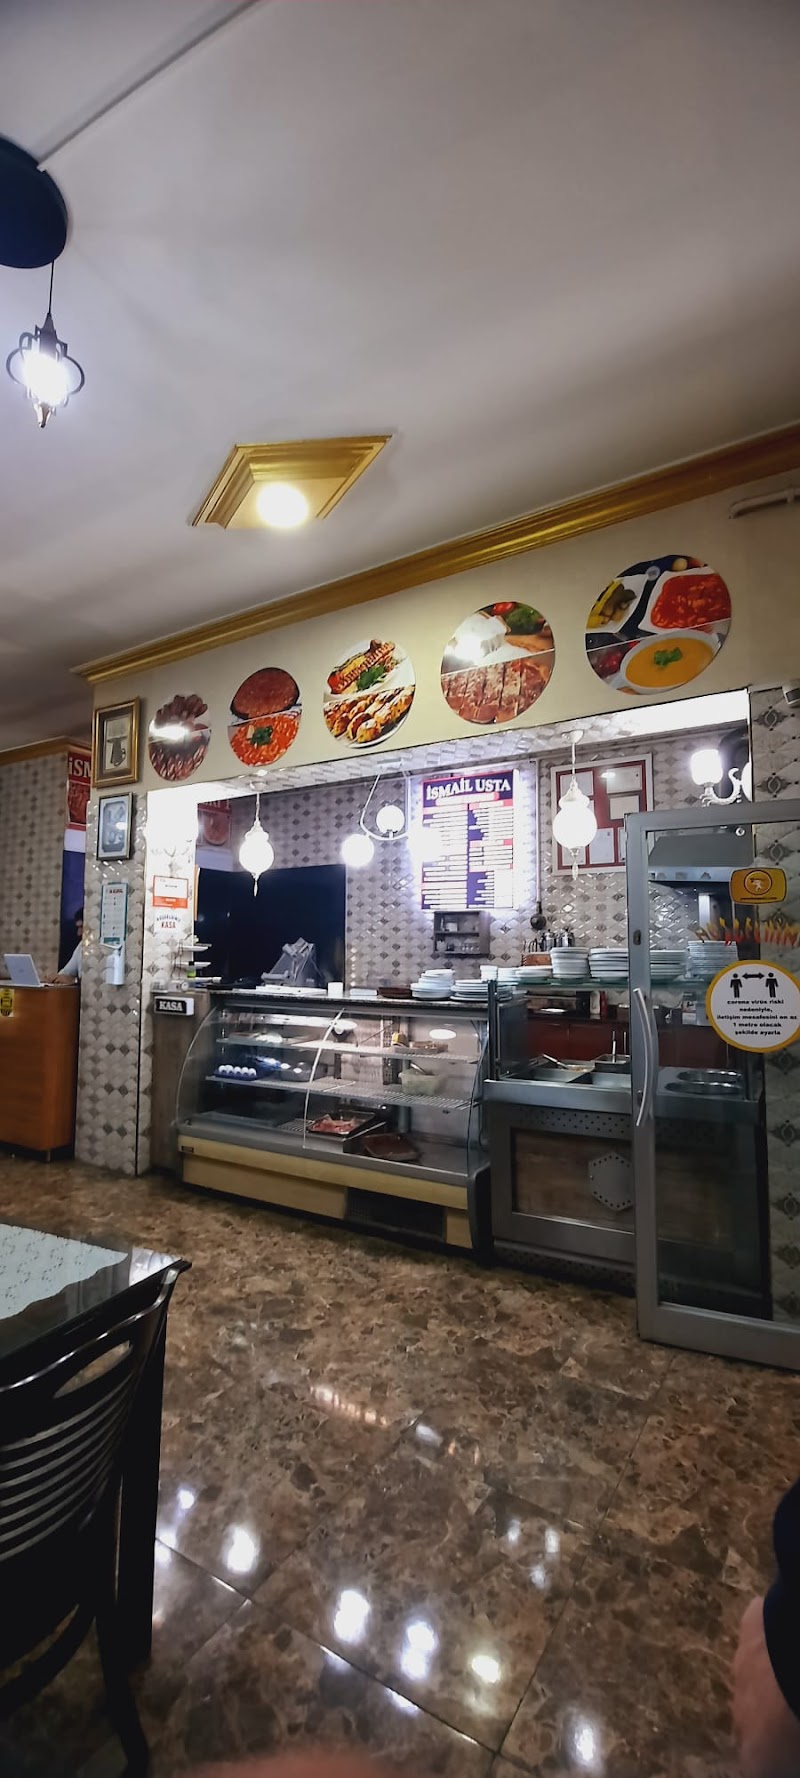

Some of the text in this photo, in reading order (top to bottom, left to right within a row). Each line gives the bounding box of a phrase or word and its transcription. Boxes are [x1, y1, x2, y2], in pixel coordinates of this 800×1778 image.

[426, 778, 511, 799] İSMAİL USTA
[159, 1000, 183, 1011] KASA
